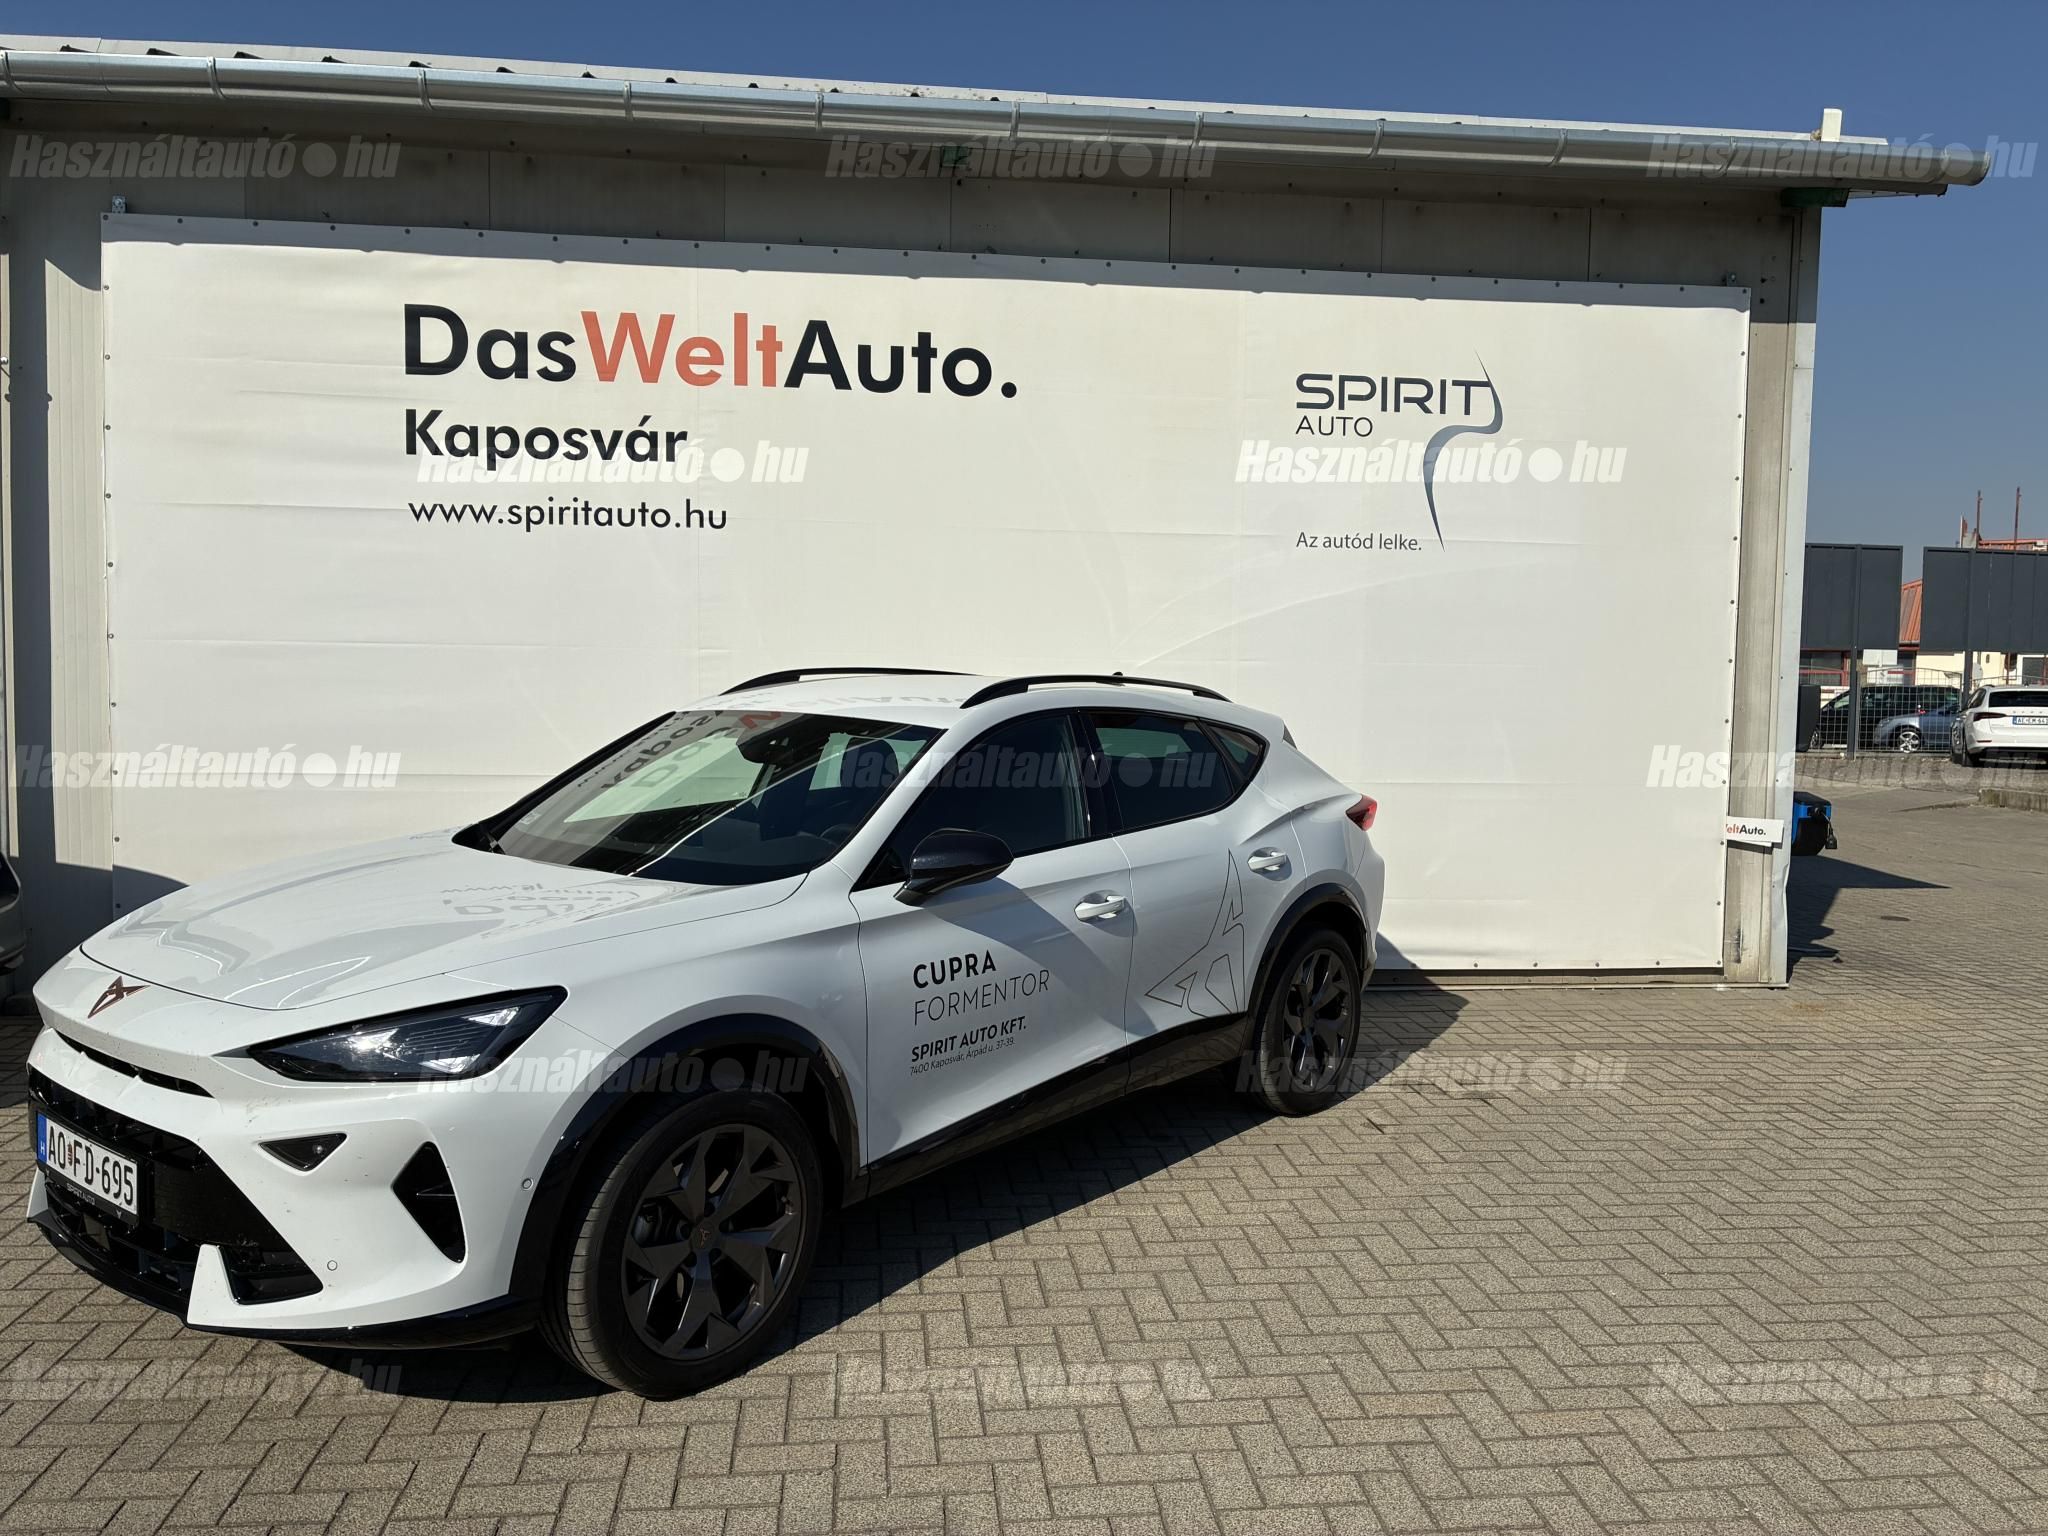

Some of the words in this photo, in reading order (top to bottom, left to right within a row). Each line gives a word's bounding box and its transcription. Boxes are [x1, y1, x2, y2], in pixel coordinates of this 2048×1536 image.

[404, 303, 1018, 399] DasWeltAuto.
[1295, 373, 1493, 416] SPIRIT
[405, 408, 688, 471] Kaposvár
[1295, 415, 1374, 438] AUTO
[408, 496, 728, 533] www.spiritauto.hu
[1296, 532, 1319, 549] Az
[1322, 532, 1374, 550] autód
[1378, 533, 1423, 552] lelke.
[913, 949, 997, 989] CUPRA
[914, 969, 1050, 1026] FORMENTOR
[911, 1035, 958, 1062] SPIRIT
[959, 1024, 998, 1048] AUTO
[1000, 1015, 1027, 1036] KFT.
[909, 1062, 930, 1076] 7400
[40, 1141, 46, 1156] H
